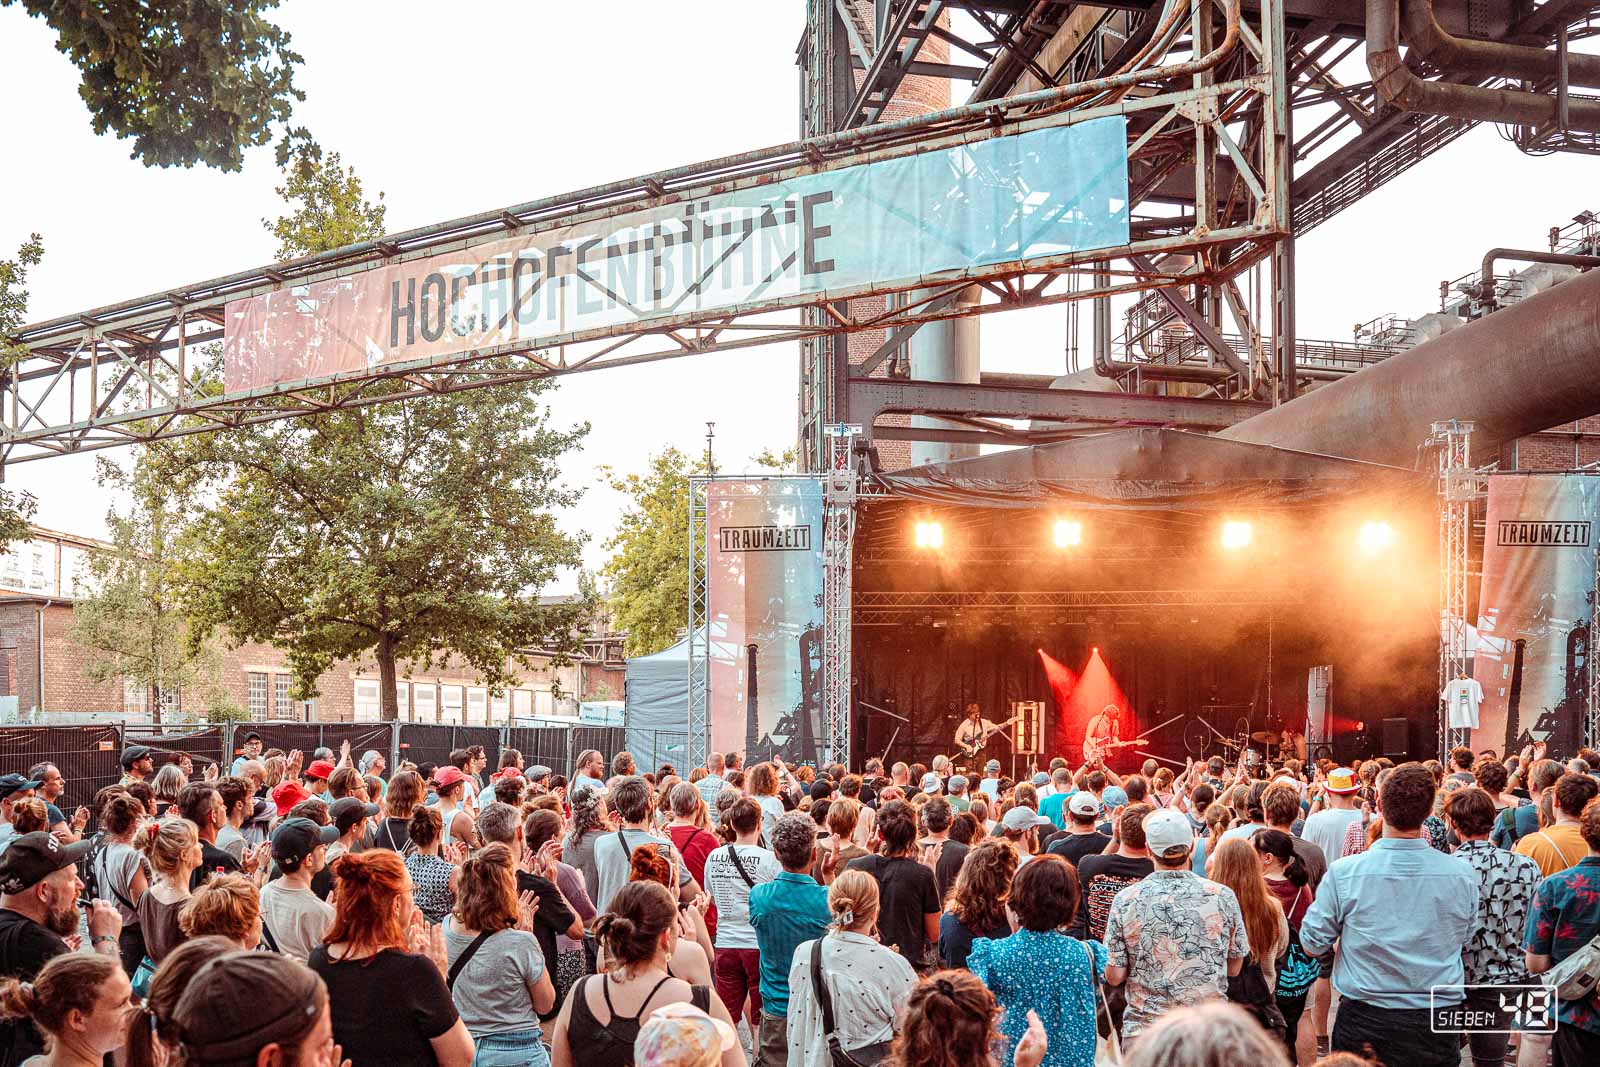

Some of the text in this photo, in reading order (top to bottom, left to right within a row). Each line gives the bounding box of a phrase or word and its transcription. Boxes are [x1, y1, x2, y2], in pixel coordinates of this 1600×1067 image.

[390, 190, 835, 348] HOCHOFENBÜHNE
[722, 528, 808, 549] TRAUMZEIT
[1501, 523, 1589, 544] TRAUMZEIT
[710, 853, 761, 865] ILLUNATI
